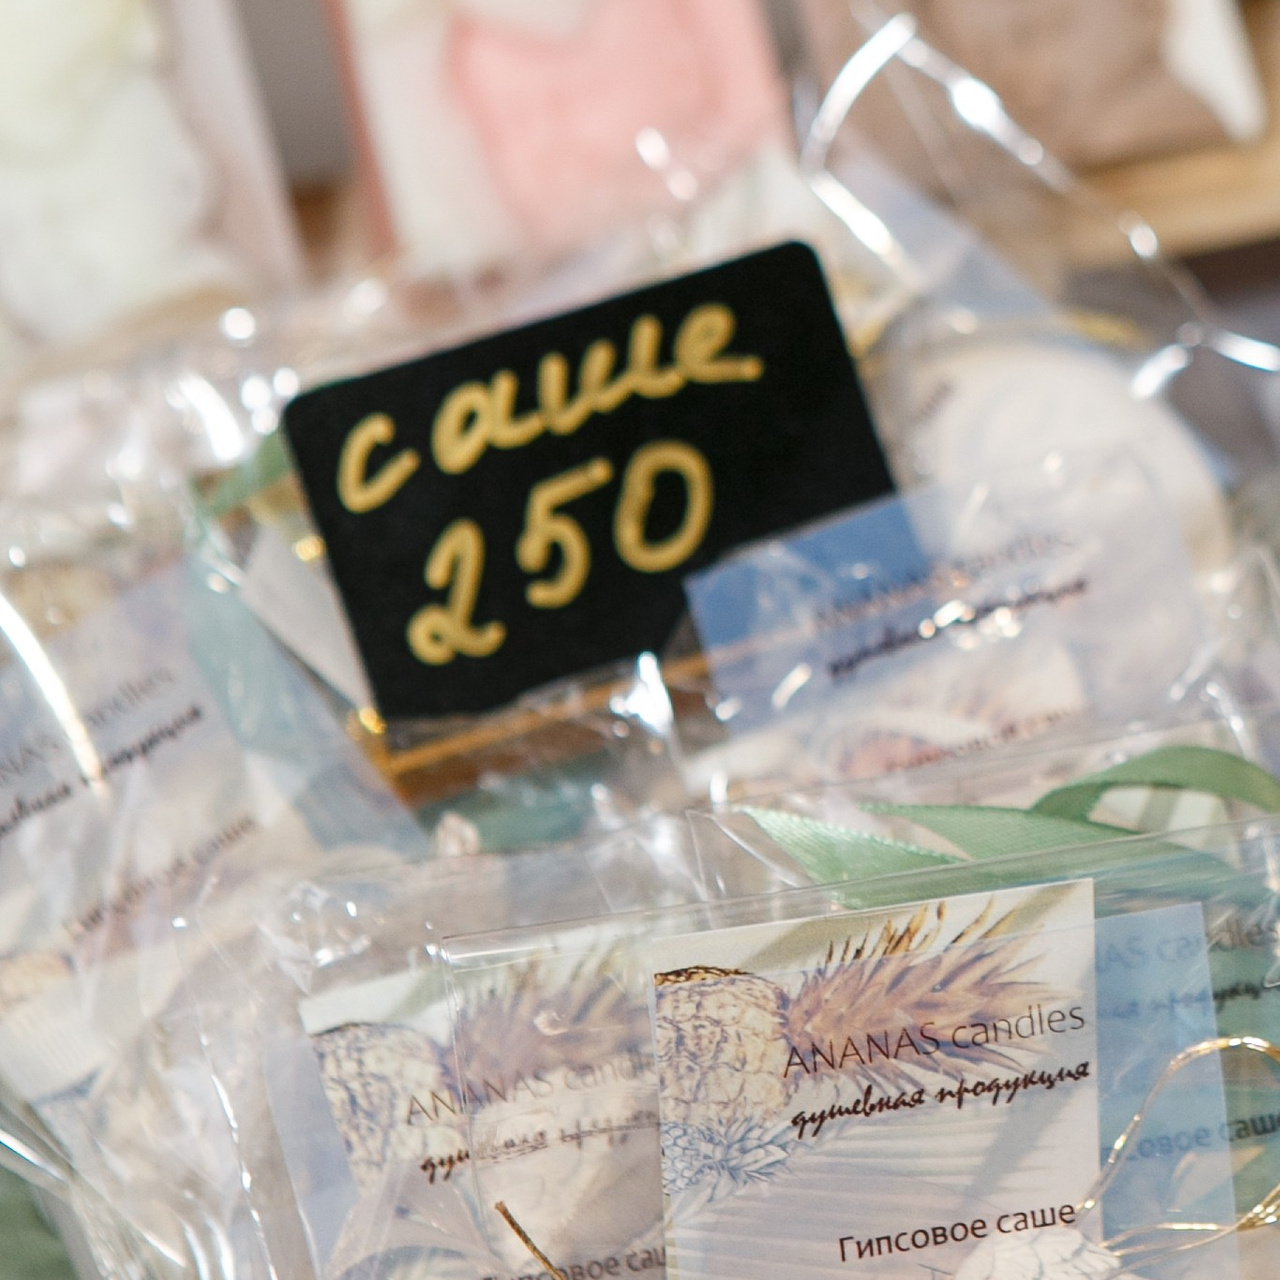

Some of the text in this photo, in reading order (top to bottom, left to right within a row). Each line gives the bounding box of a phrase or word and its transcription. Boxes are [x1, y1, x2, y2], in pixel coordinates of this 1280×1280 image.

[337, 303, 764, 514] саше
[407, 439, 715, 666] 250
[783, 1021, 941, 1079] ANANAS
[951, 1003, 1086, 1050] candles
[790, 1060, 1090, 1140] душевная продукция
[838, 1203, 1076, 1262] Гипсовое саше
